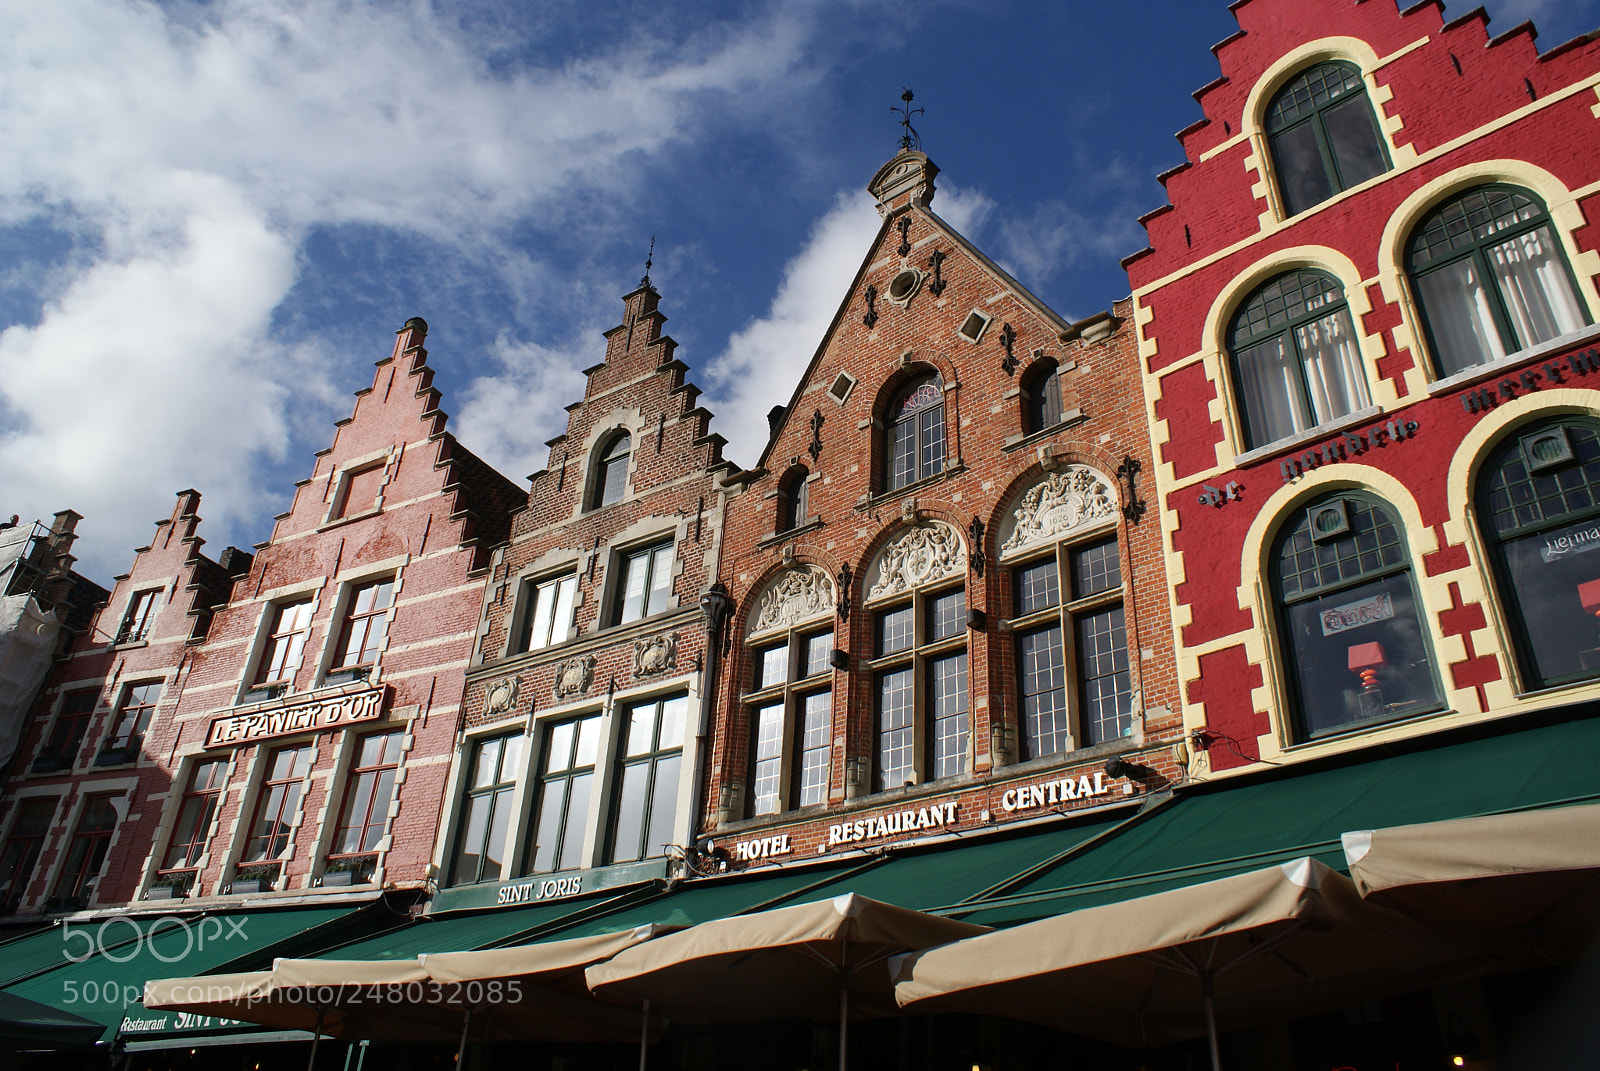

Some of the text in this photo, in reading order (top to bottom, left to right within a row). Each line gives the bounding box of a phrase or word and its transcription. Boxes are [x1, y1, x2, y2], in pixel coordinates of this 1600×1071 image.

[1203, 480, 1239, 507] de
[1279, 417, 1409, 483] gouden
[212, 690, 381, 744] LE PANIER D'OR
[736, 772, 1108, 862] HOTEL RESTAURANT CENTRAL
[497, 876, 582, 904] SINT JORIS
[120, 1016, 168, 1032] Restaurant
